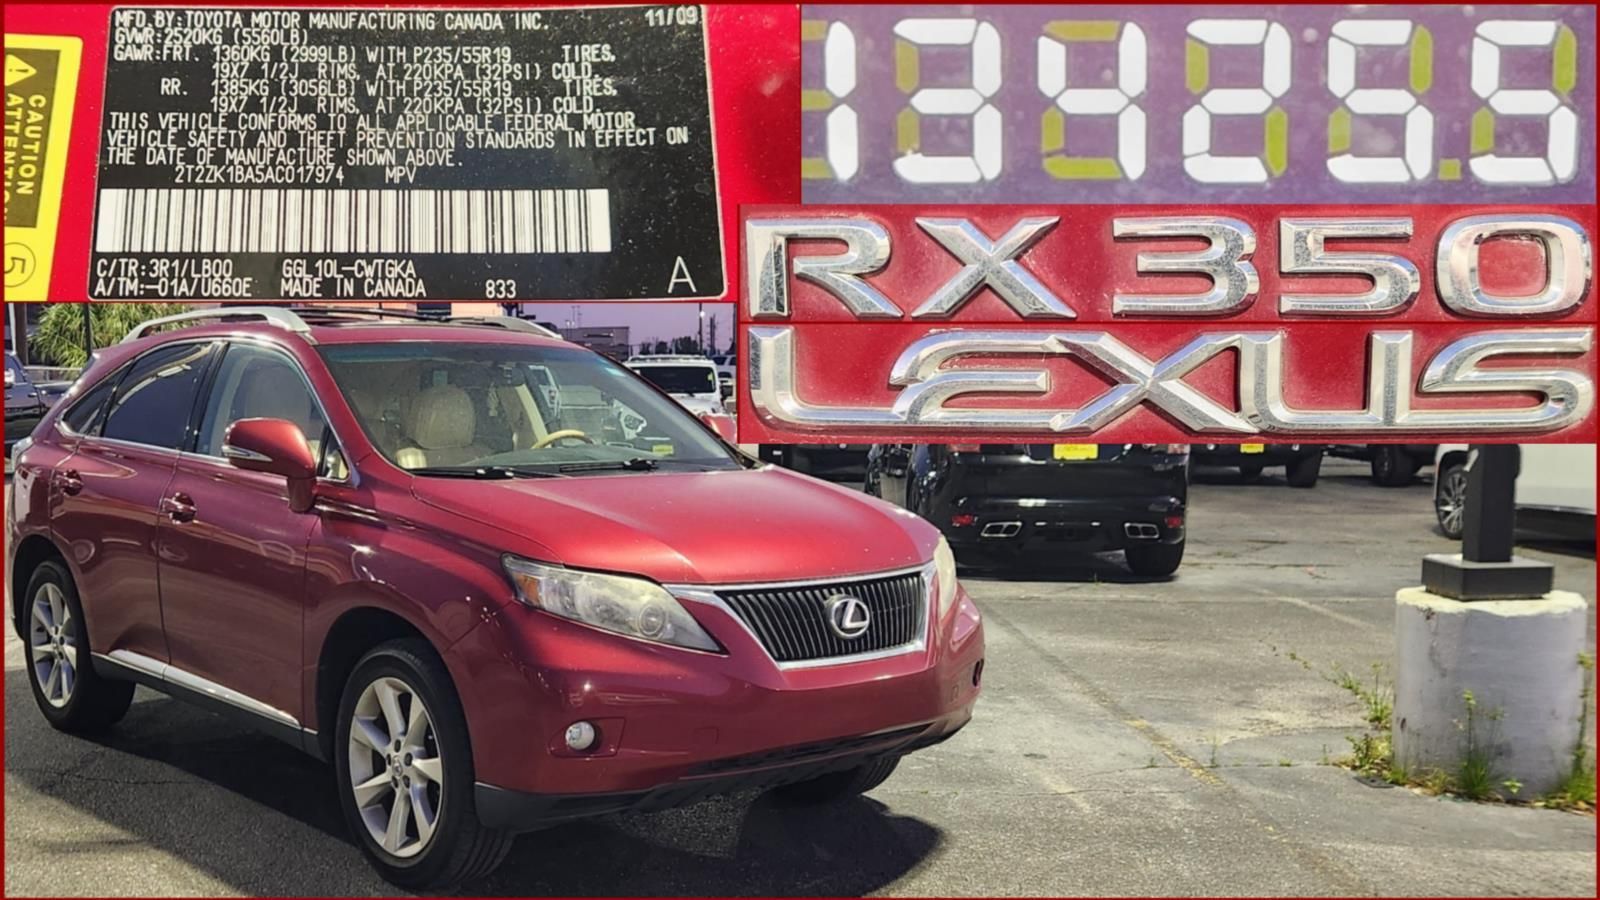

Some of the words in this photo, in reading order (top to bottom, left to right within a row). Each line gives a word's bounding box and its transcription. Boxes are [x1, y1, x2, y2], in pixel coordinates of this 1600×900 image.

[251, 13, 300, 28] MOTOR
[309, 13, 434, 30] MANUFACTURING
[445, 13, 503, 30] CANADA
[515, 13, 550, 30] INC.
[645, 6, 698, 26] 11/09
[233, 29, 309, 45] (5560LB)
[213, 46, 270, 62] 1360KG
[282, 46, 356, 63] (2999LB)
[367, 47, 405, 63] WITH
[413, 46, 511, 63] P235/55R19
[212, 63, 250, 78] 19X7
[261, 63, 298, 79] 1/2J
[376, 64, 400, 80] AT
[404, 64, 464, 80] 220KPA
[476, 64, 541, 80] (32PSI)
[552, 63, 601, 79] COLD.
[161, 79, 188, 95] RR.
[211, 79, 269, 95] 1385KG
[280, 80, 356, 96] (3056LB)
[367, 80, 405, 96] WITH
[413, 80, 512, 97] P235/55R19
[211, 96, 248, 112] 19X7
[260, 96, 298, 113] 1/2J
[376, 97, 400, 113] AT
[404, 97, 464, 114] 220KPA
[476, 97, 541, 114] (32PSI)
[553, 97, 601, 113] COLD.
[110, 112, 148, 129] THIS
[158, 113, 227, 130] VEHICLE
[238, 113, 317, 130] CONFORMS
[328, 114, 346, 130] TO
[357, 114, 385, 131] ALL
[396, 113, 493, 131] APPLICABLE
[505, 113, 574, 131] FEDERAL
[584, 112, 635, 129] MOTOR
[16, 94, 47, 195] CAUTION
[107, 130, 176, 147] VEHICLE
[187, 130, 247, 147] SAFETY
[257, 131, 286, 148] AND
[298, 131, 345, 148] THEFT
[356, 131, 455, 149] PREVENTION
[466, 130, 555, 148] STANDARDS
[568, 129, 586, 147] IN
[595, 128, 655, 146] EFFECT
[666, 126, 688, 144] ON
[107, 148, 135, 165] THE
[146, 148, 185, 165] DATE
[196, 148, 216, 165] OF
[226, 148, 335, 166] MANUFACTURE
[347, 149, 396, 166] SHOWN
[405, 149, 463, 167] ABOVE.
[175, 165, 344, 185] 2T2ZK1BA5AC017974
[385, 166, 418, 184] MPV
[282, 259, 416, 278] GGL10L-CWTGKA
[667, 256, 696, 294] A
[745, 215, 1077, 320] RX
[1111, 212, 1593, 319] 350
[281, 278, 322, 297] MADE
[335, 278, 355, 297] IN
[364, 278, 427, 298] CANADA
[485, 280, 516, 299] 833
[747, 325, 1596, 435] LEXUS
